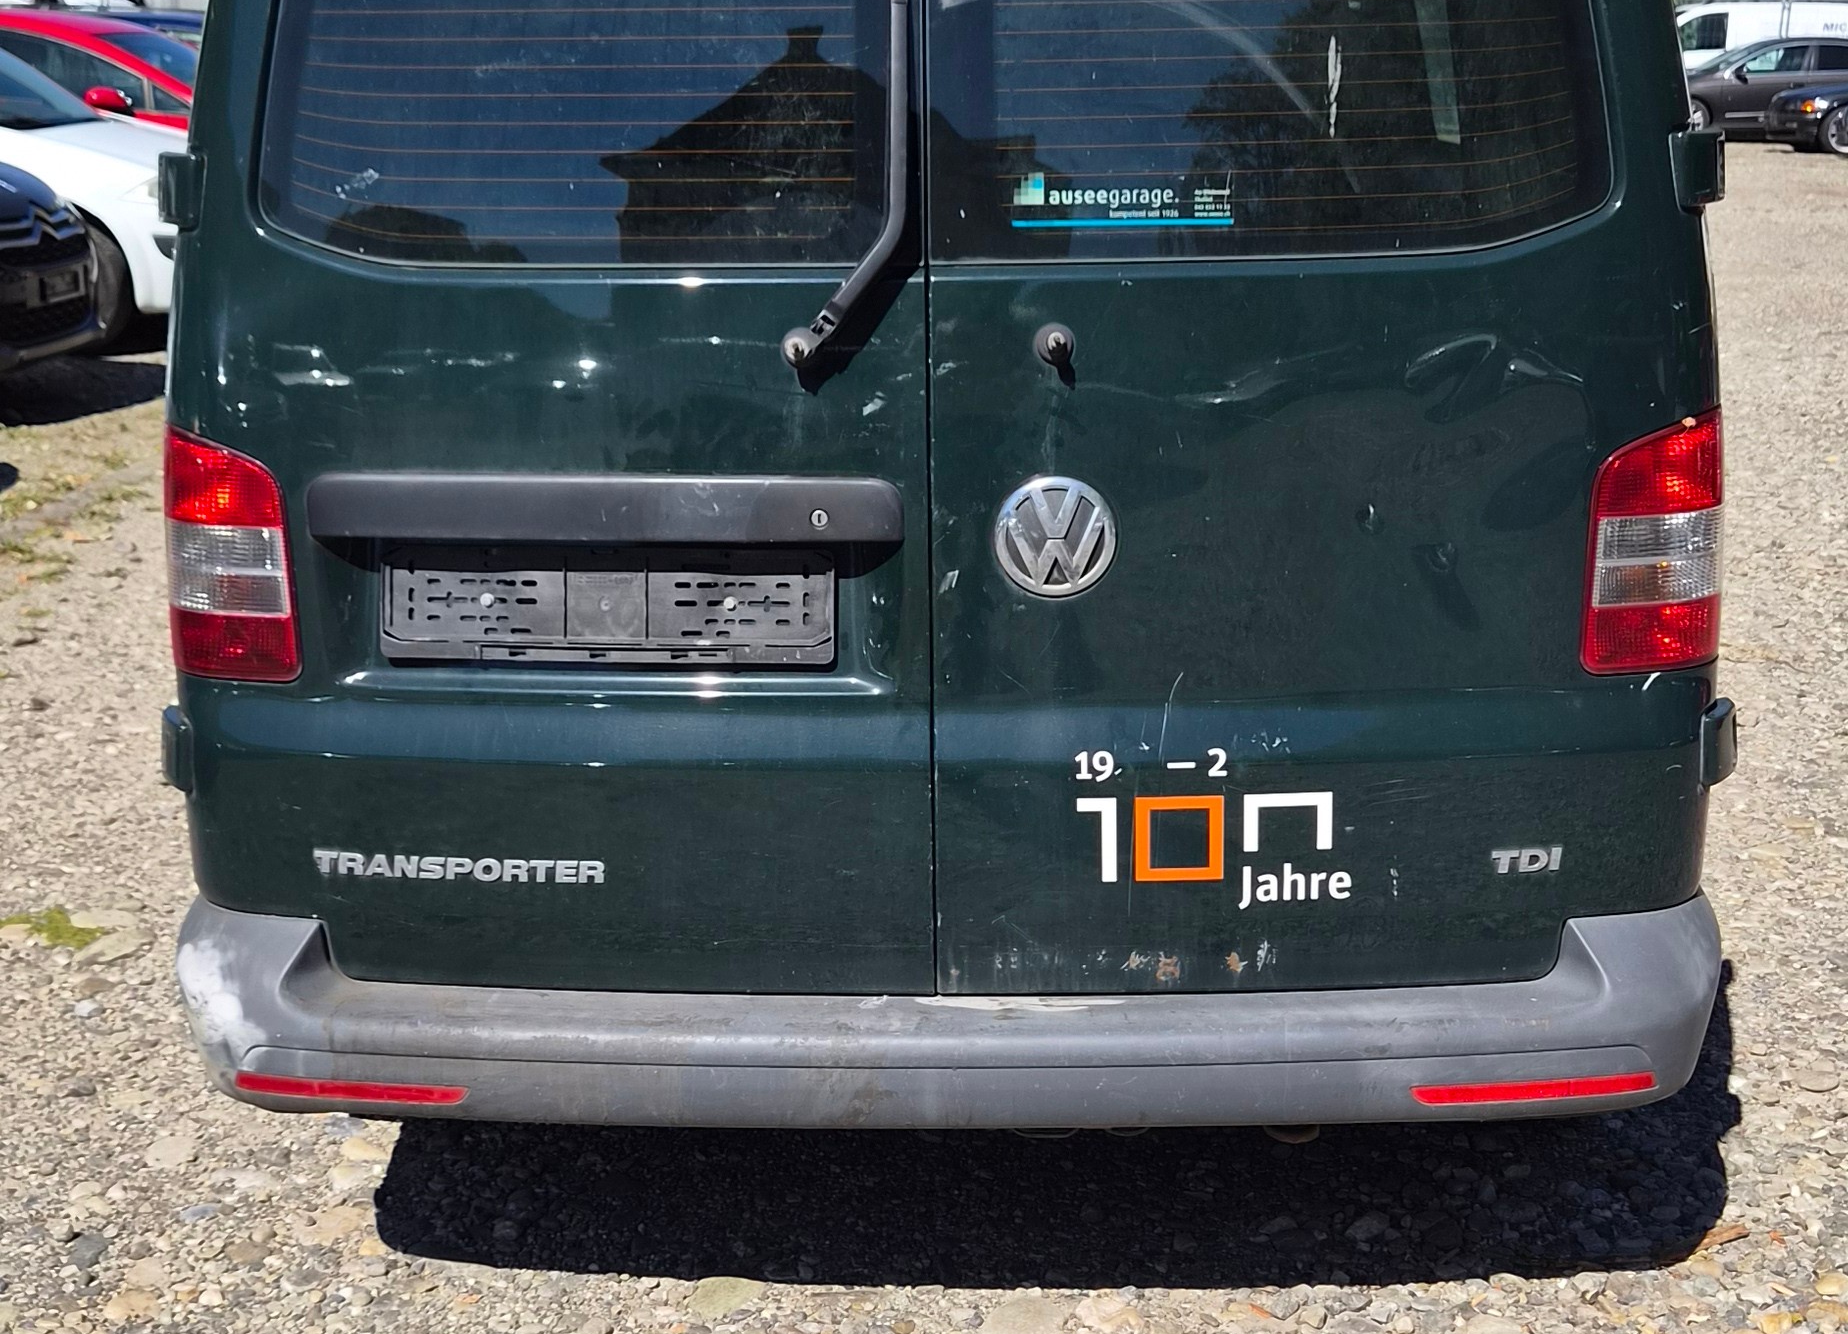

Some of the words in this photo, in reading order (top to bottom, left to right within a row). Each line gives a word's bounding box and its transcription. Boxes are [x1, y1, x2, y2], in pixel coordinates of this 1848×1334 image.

[1048, 187, 1180, 209] auseegarage.
[1074, 750, 1123, 782] 19
[312, 847, 606, 884] TRANSPORTER
[1491, 845, 1563, 875] TDI
[1238, 862, 1352, 910] Jahre
